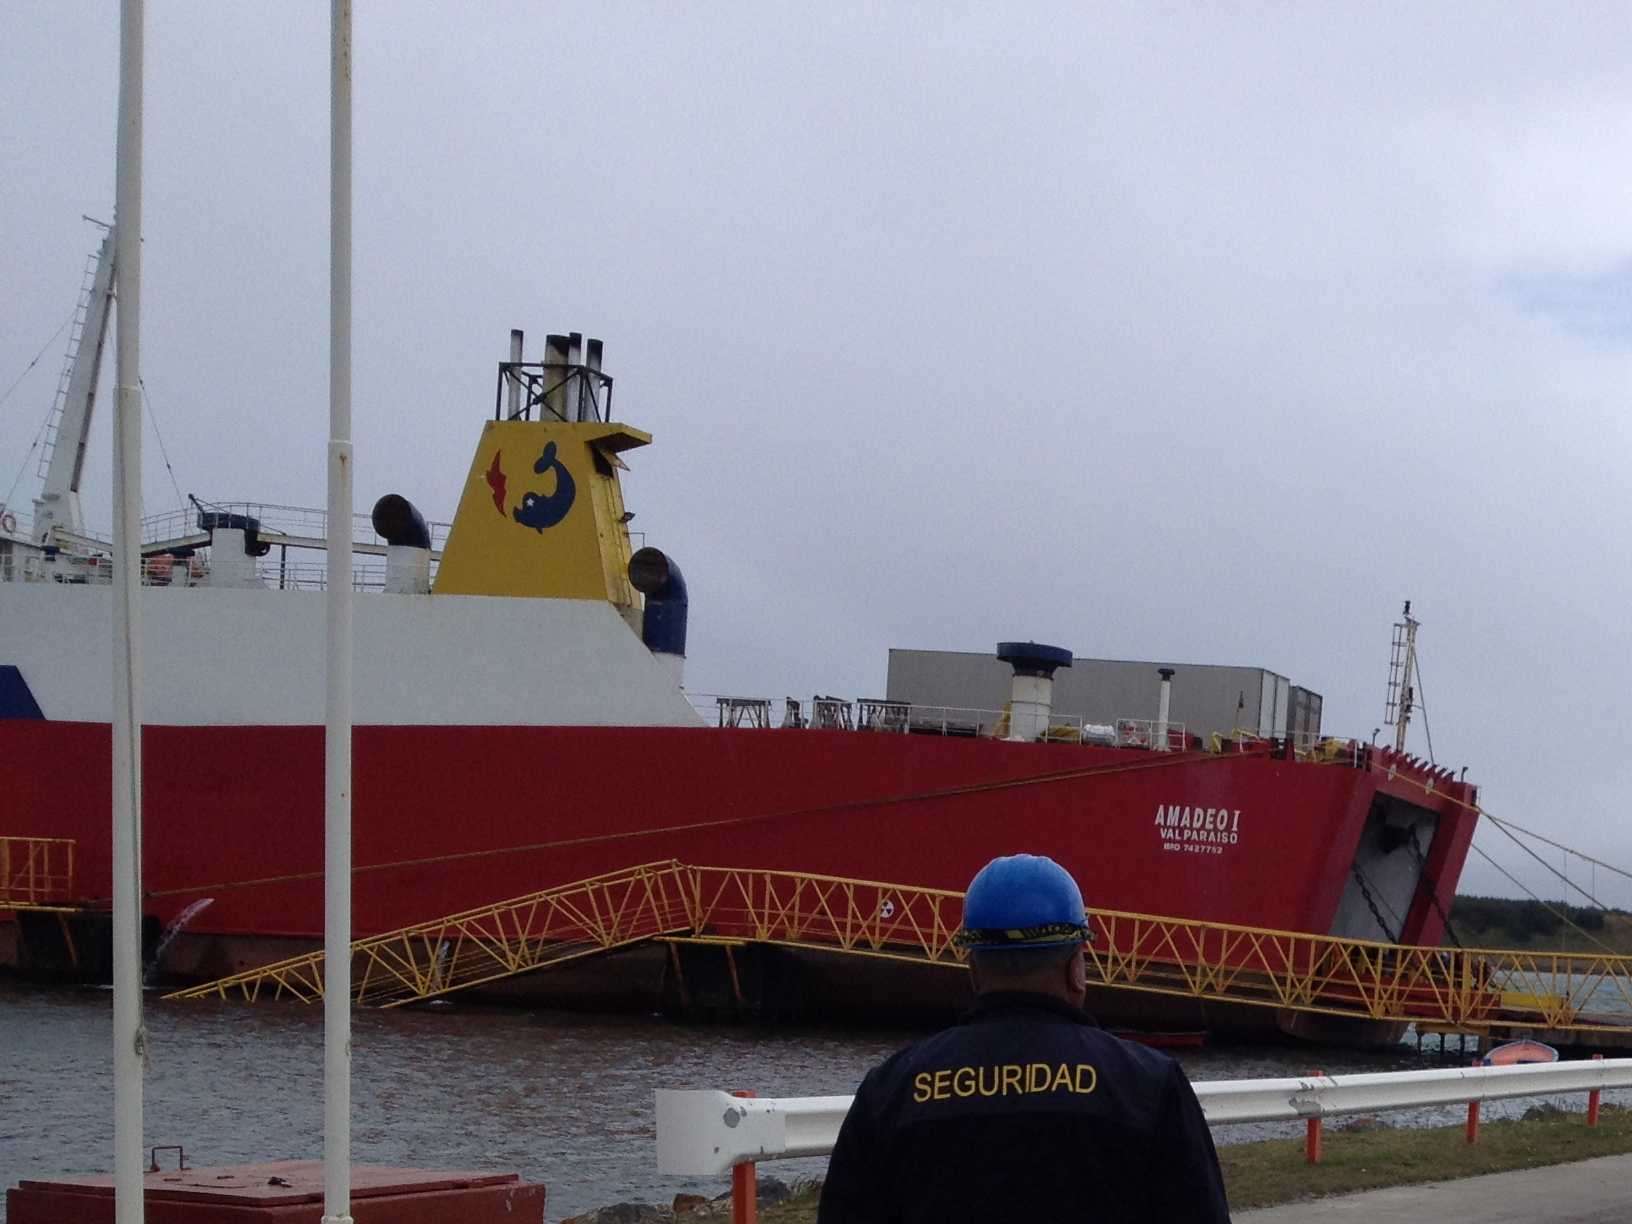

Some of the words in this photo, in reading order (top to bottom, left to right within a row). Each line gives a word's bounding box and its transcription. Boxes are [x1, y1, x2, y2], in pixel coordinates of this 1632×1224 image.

[1154, 804, 1229, 831] AMADEO
[1231, 810, 1241, 832] I
[1160, 828, 1239, 844] VALPARAISO
[913, 1063, 1097, 1103] SEGURIDAD
